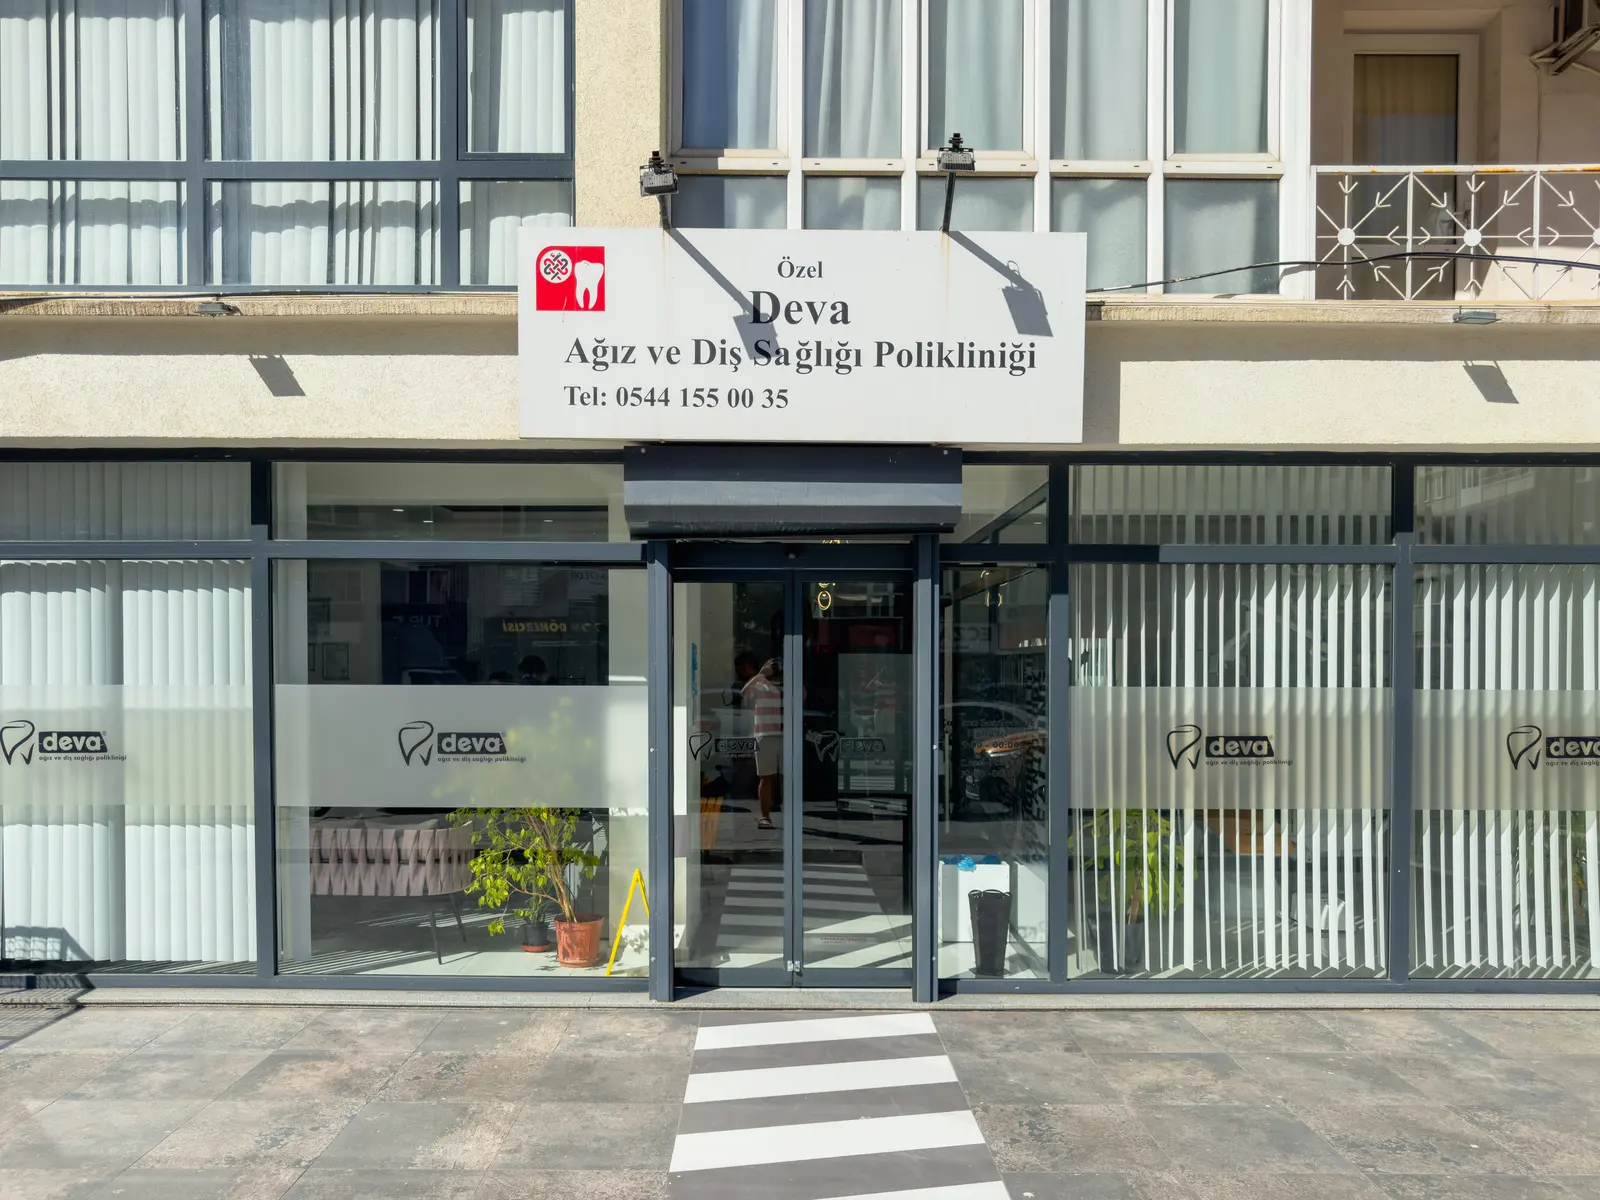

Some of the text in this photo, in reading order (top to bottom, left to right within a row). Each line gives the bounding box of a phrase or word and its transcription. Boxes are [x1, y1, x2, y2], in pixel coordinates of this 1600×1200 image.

[777, 256, 823, 279] Özel
[748, 290, 851, 325] Deva
[564, 337, 1037, 376] Ağız ve Diş Sağlığı Polikliniği
[563, 386, 789, 409] Tel: 0544 155 00 35
[42, 732, 101, 751] deva
[441, 733, 501, 753] deva
[1209, 736, 1268, 756] deva
